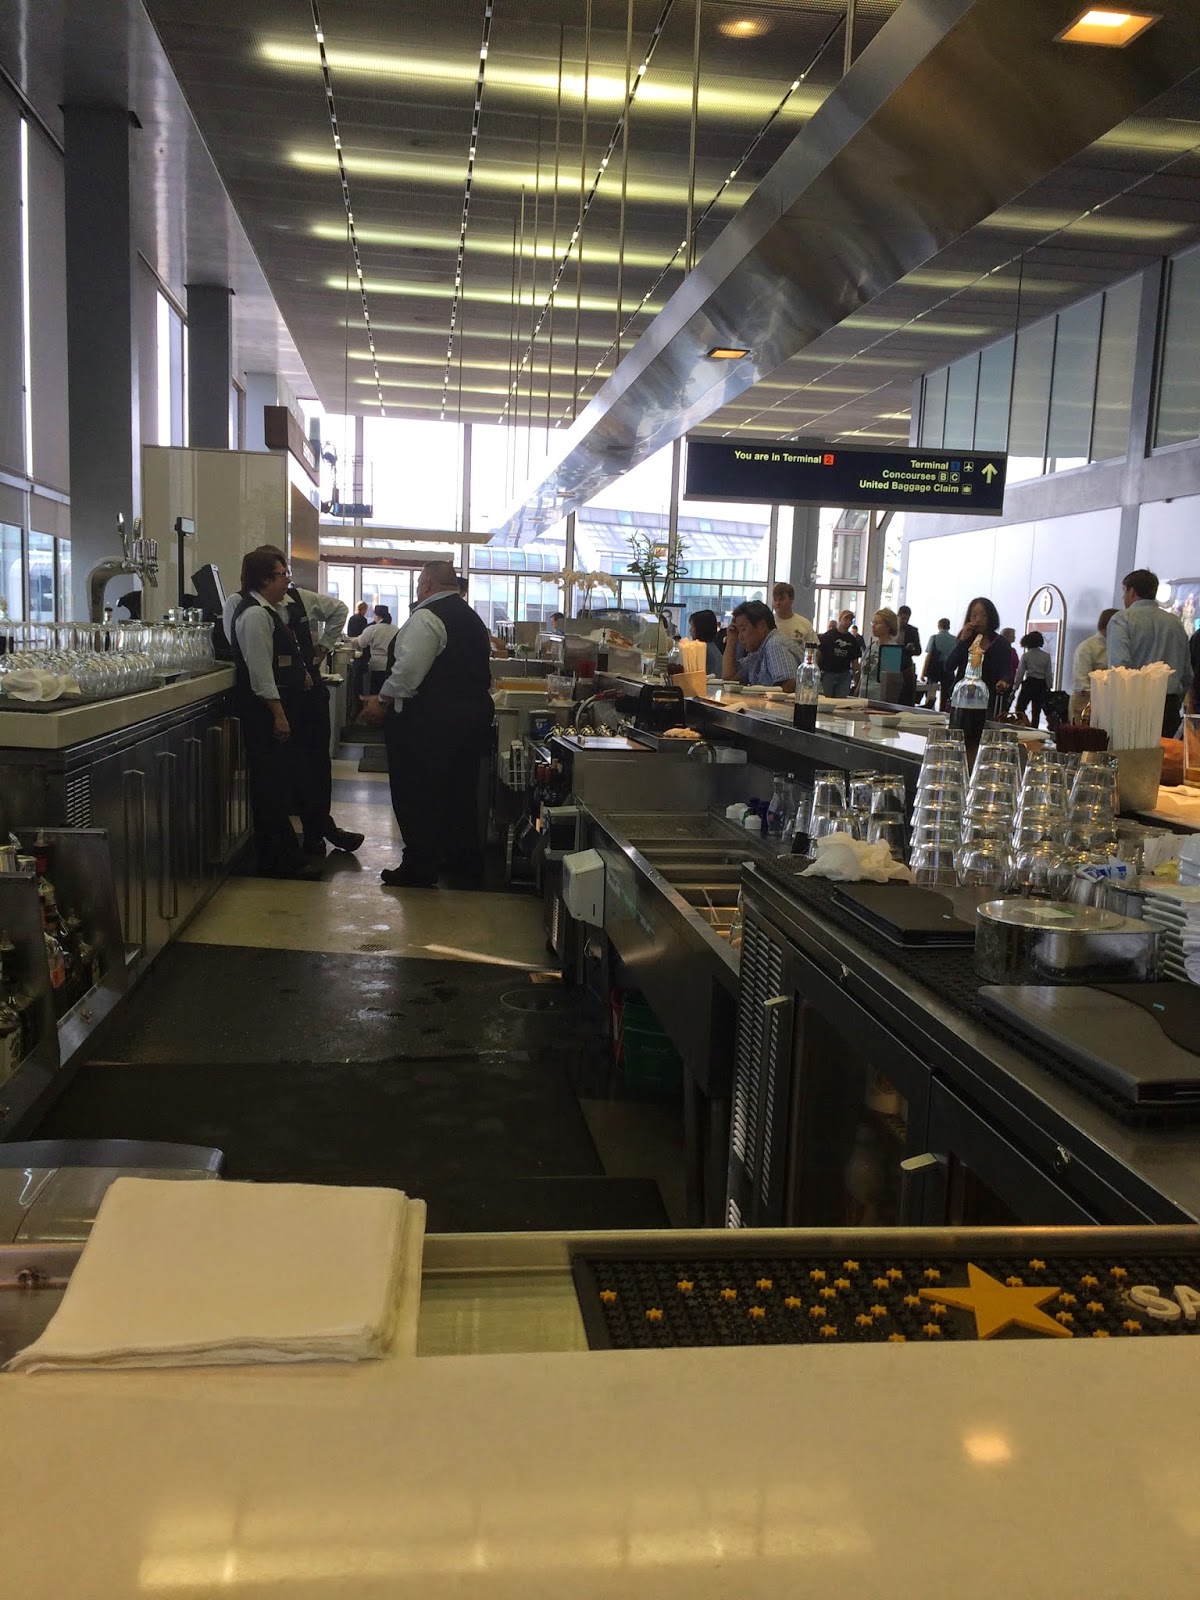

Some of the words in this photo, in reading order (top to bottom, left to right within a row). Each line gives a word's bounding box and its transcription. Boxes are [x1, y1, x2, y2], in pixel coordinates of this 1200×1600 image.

[734, 450, 752, 460] You
[754, 453, 769, 461] are
[782, 453, 822, 464] Terminal
[910, 460, 949, 470] Terminal
[882, 469, 936, 481] Concourses
[859, 480, 889, 489] United
[891, 482, 931, 493] Baggage
[933, 484, 959, 493] Claim
